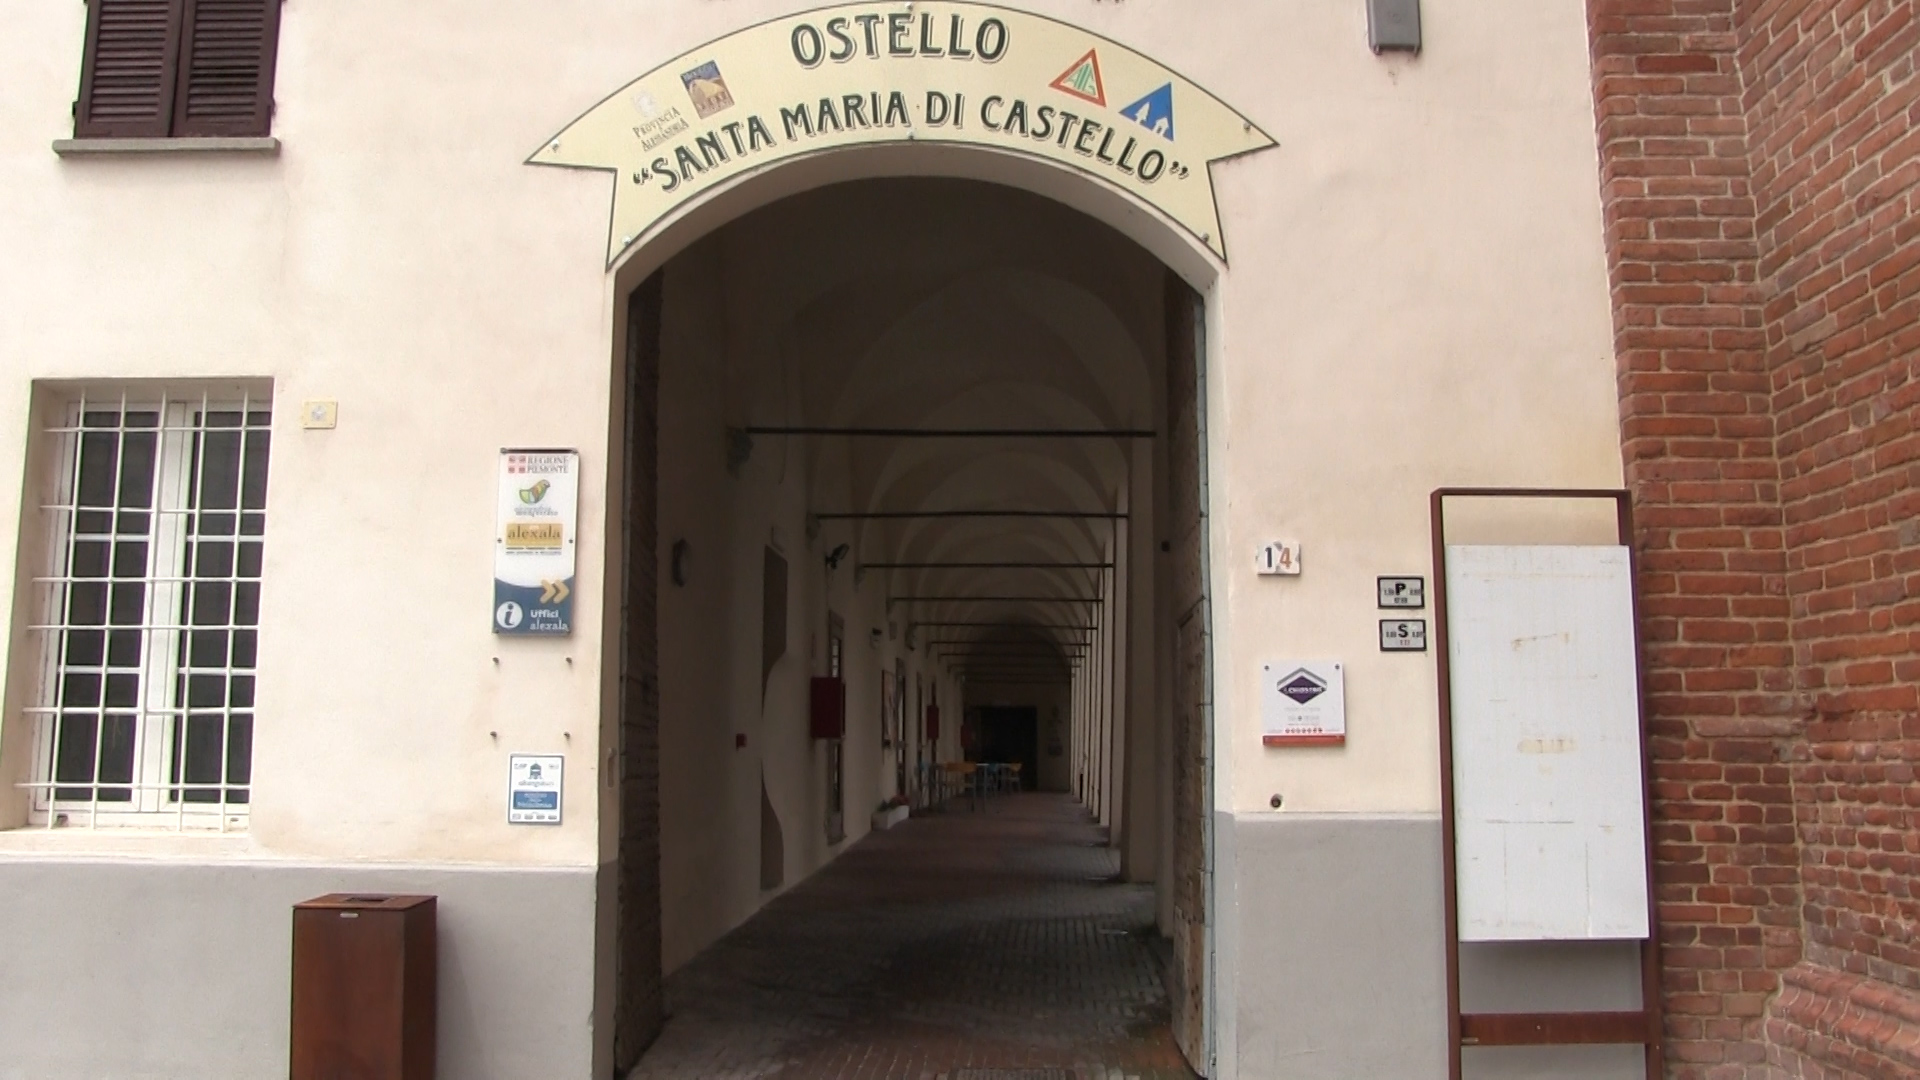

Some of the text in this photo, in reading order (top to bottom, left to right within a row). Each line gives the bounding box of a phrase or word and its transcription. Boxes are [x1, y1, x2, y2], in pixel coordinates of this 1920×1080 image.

[790, 12, 1010, 69] OSTELLO
[779, 91, 911, 141] MARIA
[925, 91, 964, 128] DI
[508, 524, 561, 539] alexala
[1265, 547, 1292, 569] 14
[1395, 582, 1406, 596] P
[529, 619, 568, 630] alexala
[1398, 623, 1408, 638] S
